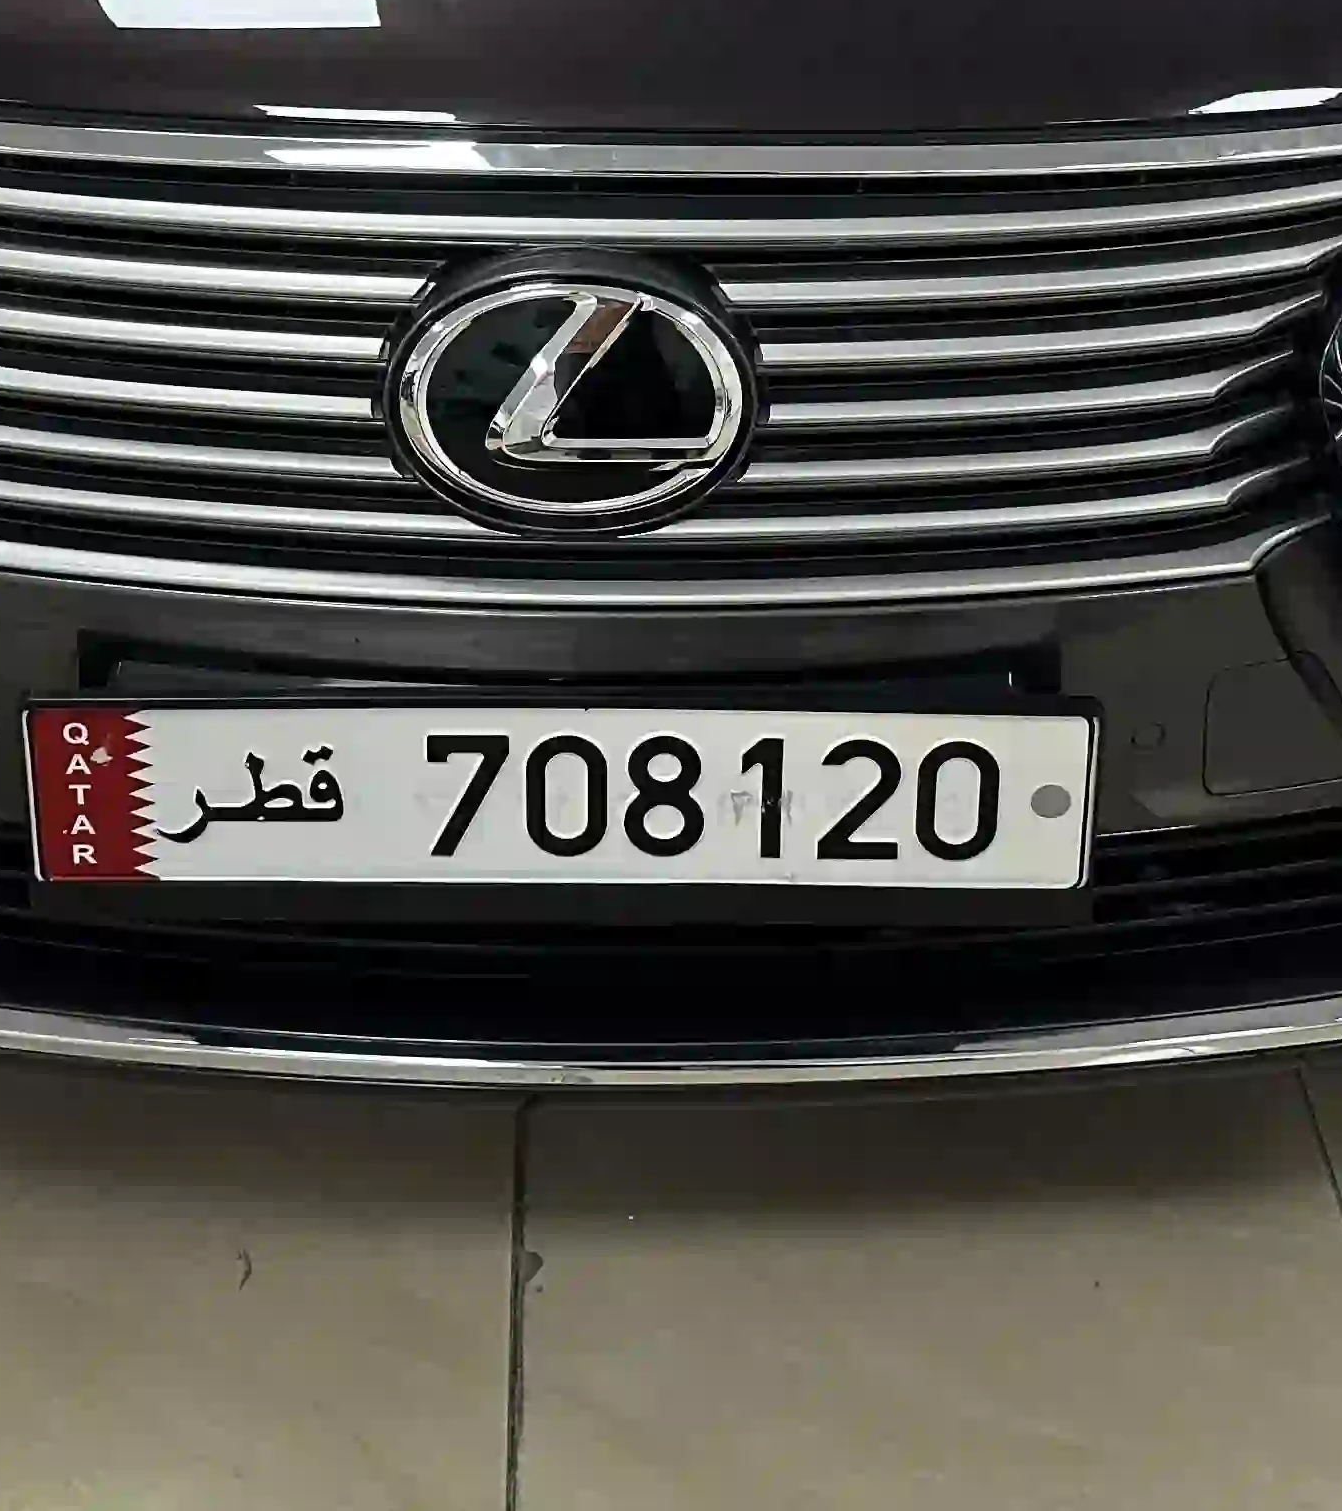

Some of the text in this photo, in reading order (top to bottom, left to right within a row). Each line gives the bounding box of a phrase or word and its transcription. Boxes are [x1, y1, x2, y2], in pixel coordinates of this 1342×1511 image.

[62, 721, 98, 865] QATAR
[156, 744, 345, 844] قطر
[425, 733, 1002, 862] 708120
